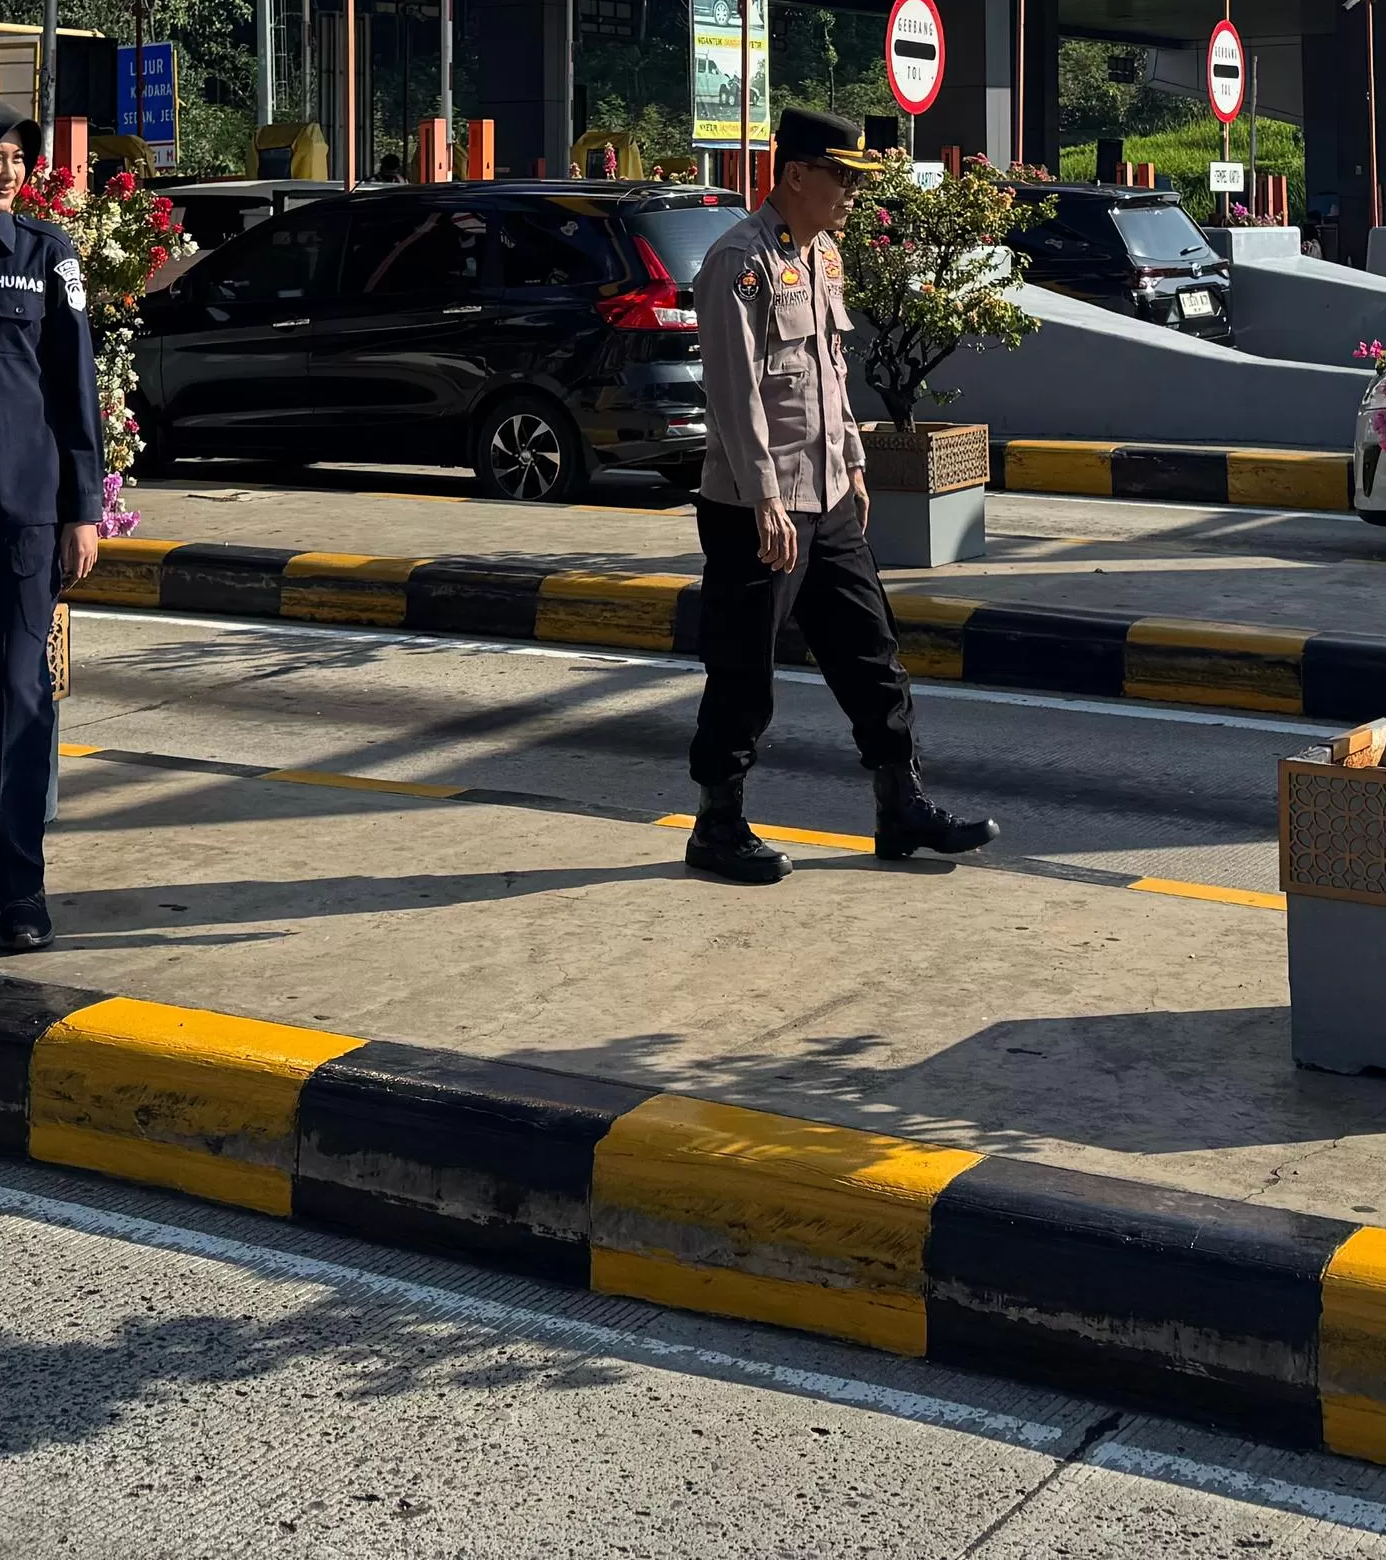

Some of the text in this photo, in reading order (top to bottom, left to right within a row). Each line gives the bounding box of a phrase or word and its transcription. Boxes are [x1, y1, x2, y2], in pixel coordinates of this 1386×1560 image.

[898, 17, 934, 37] GERBANG
[130, 59, 164, 76] LJUR
[907, 66, 922, 81] TOL
[130, 83, 172, 99] KNDARA
